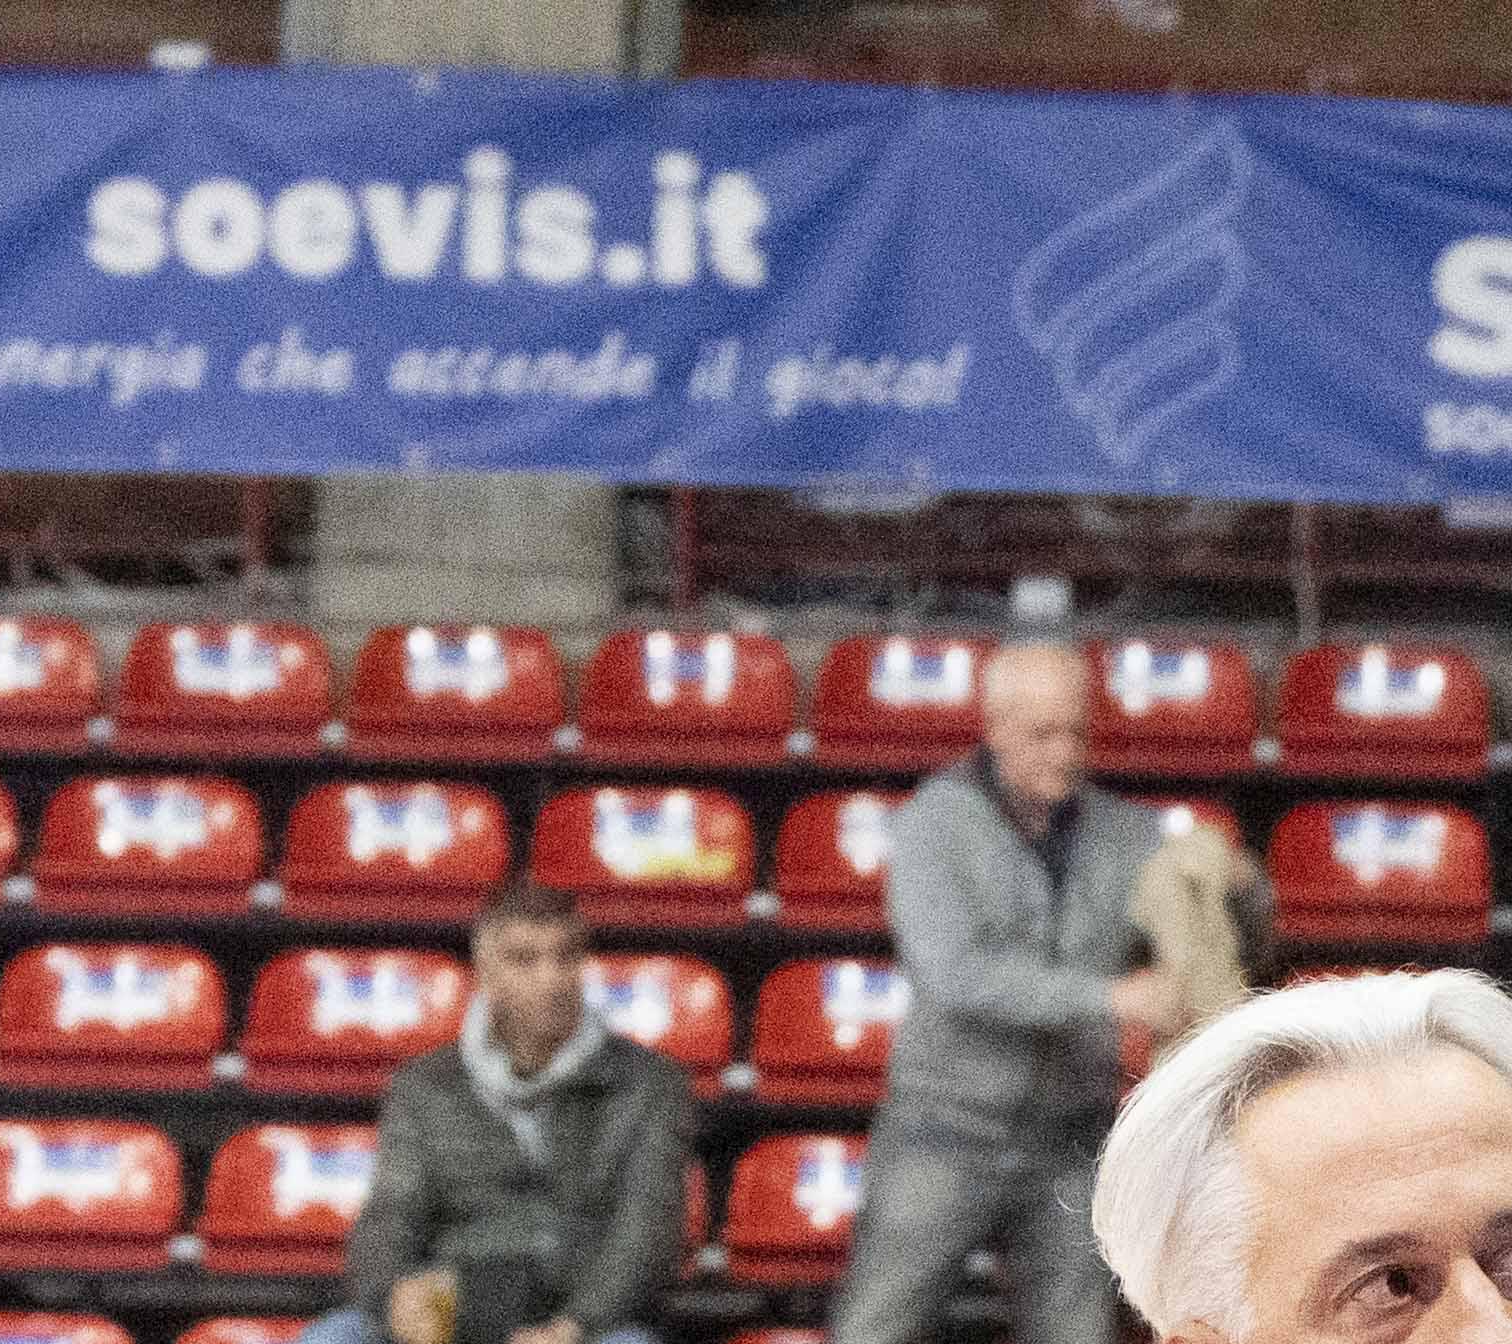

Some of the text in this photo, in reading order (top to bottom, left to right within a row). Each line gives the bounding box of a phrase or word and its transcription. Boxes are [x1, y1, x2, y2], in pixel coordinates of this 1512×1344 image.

[88, 145, 768, 287] soevis.it
[234, 330, 353, 397] che
[688, 340, 736, 405] il
